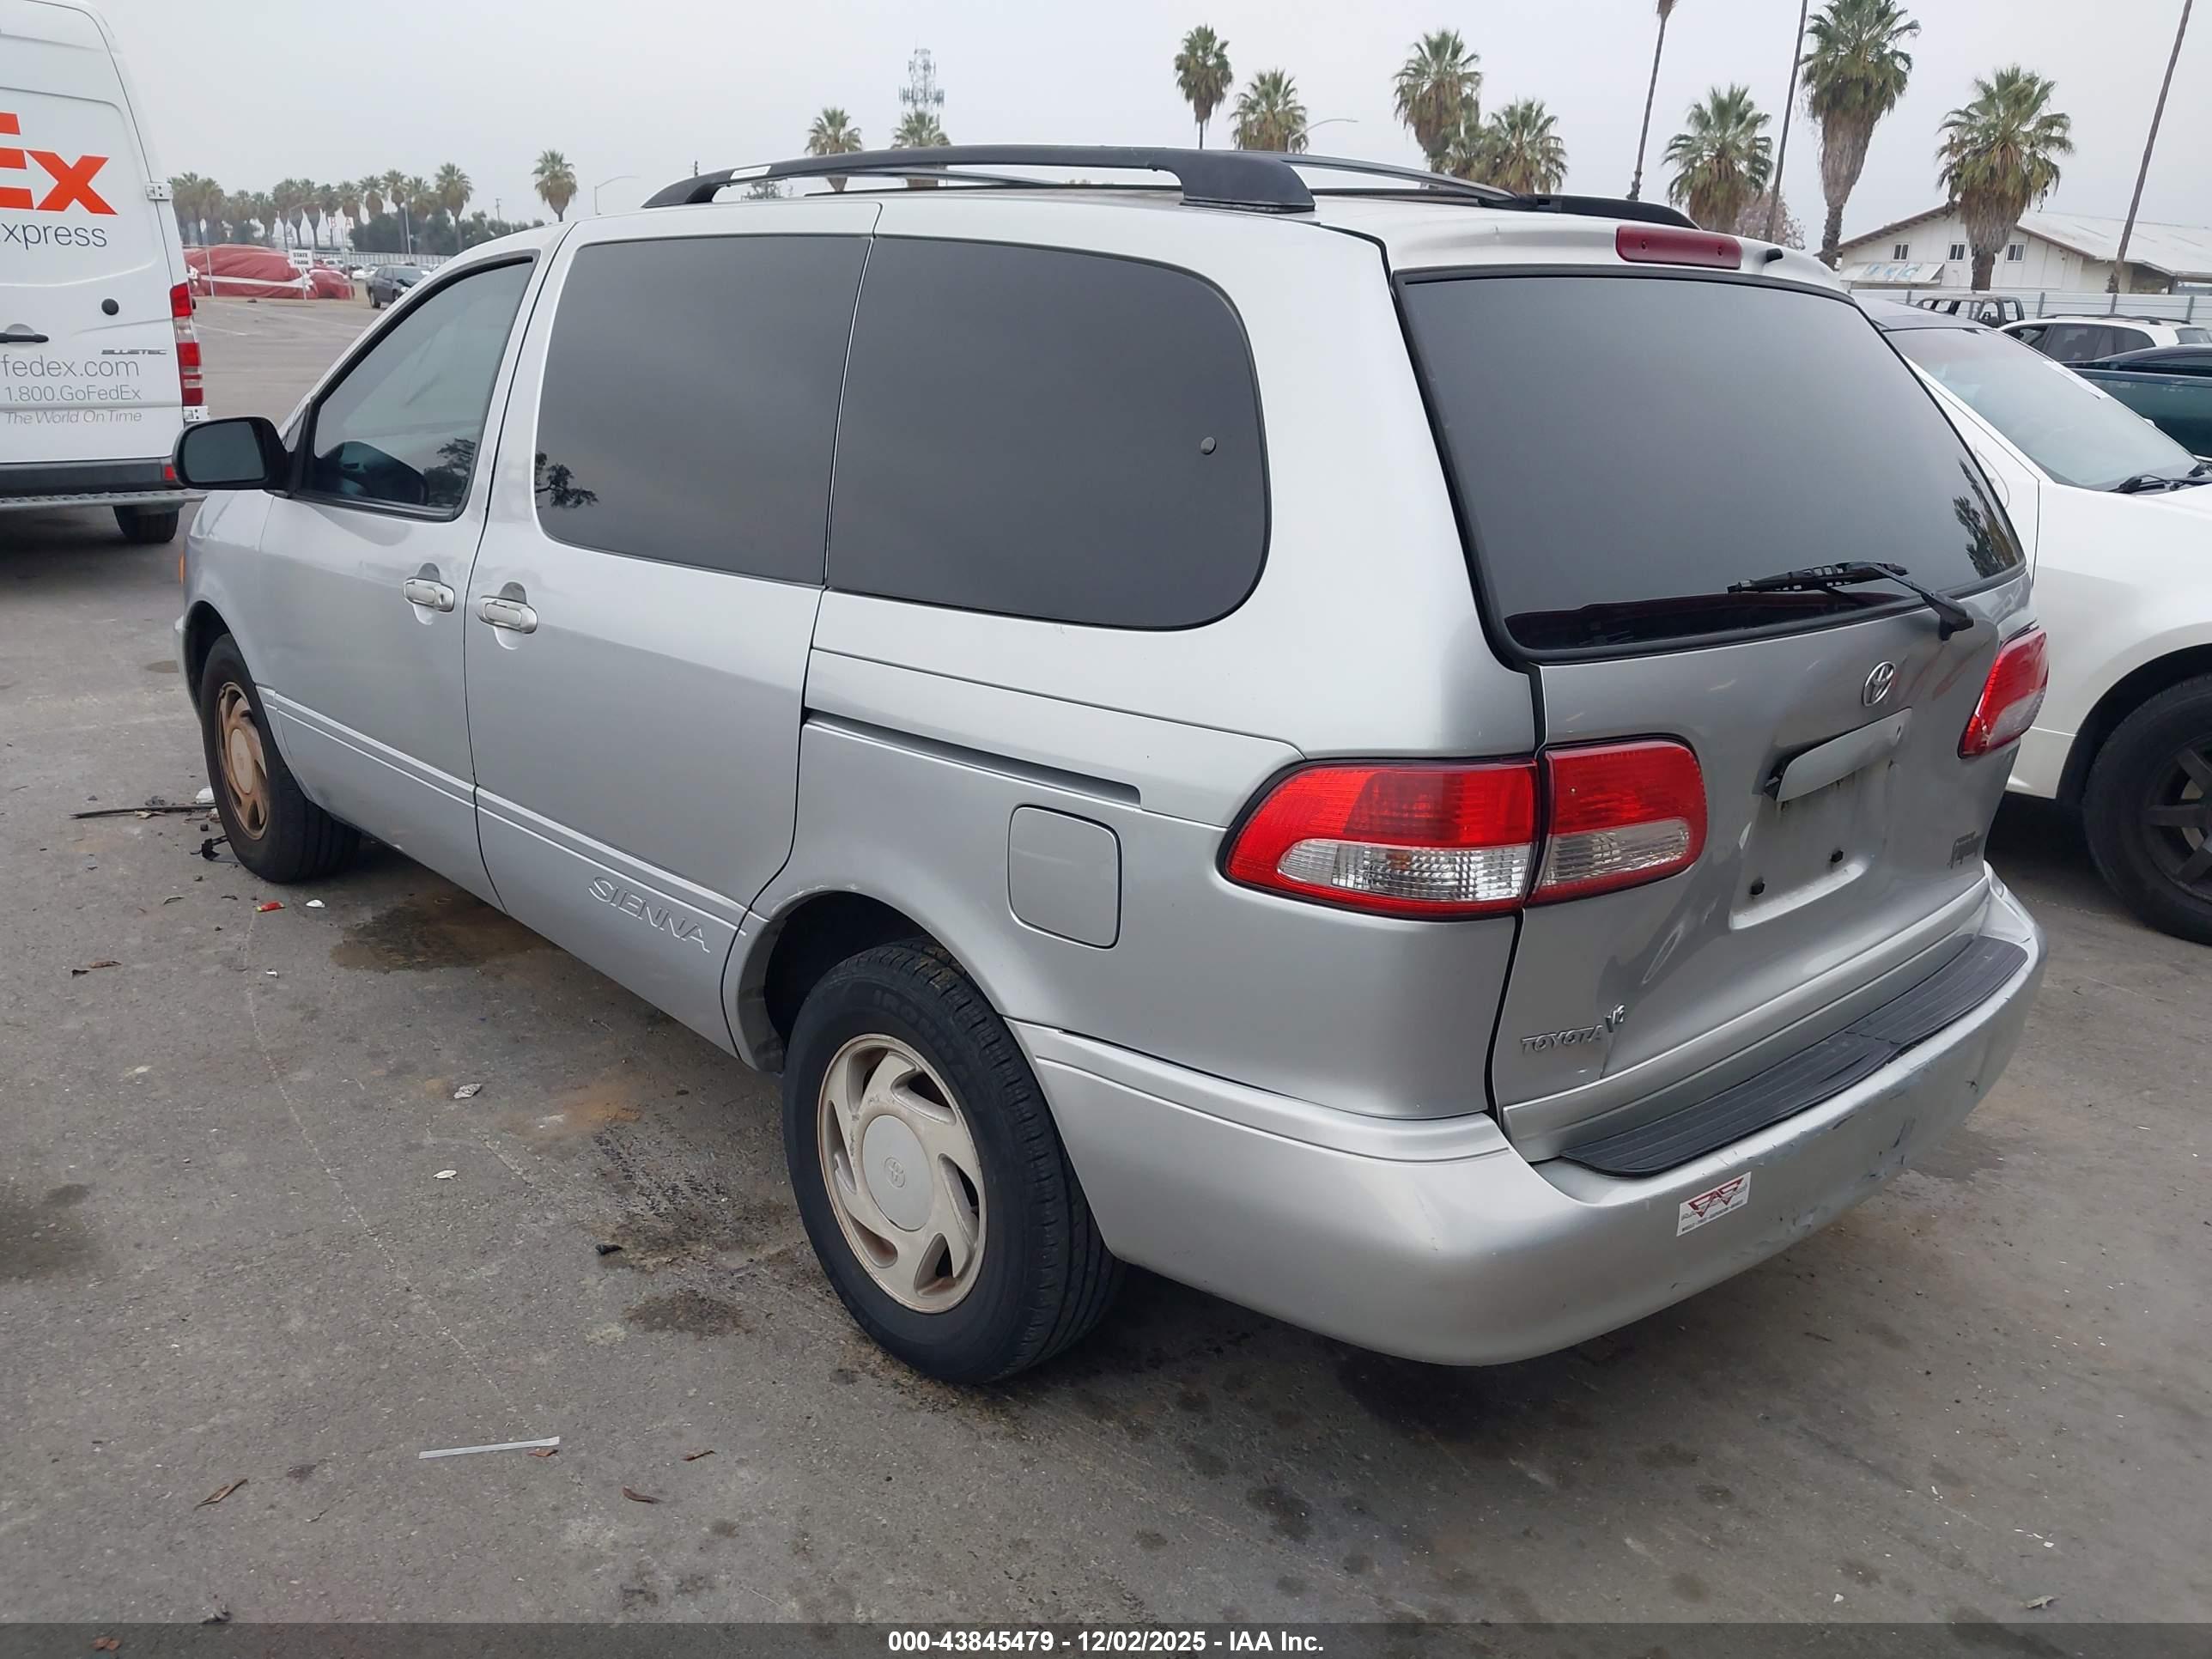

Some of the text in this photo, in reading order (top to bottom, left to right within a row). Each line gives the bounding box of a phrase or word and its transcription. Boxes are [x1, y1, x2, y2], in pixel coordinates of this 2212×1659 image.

[0, 222, 107, 251] xpress
[1, 354, 139, 377] fedex.com
[5, 385, 142, 402] 1.800.GoFedEx
[6, 410, 143, 424] The World On Time
[588, 877, 711, 953] SIENNA
[1520, 1024, 1603, 1054] TOYOTA
